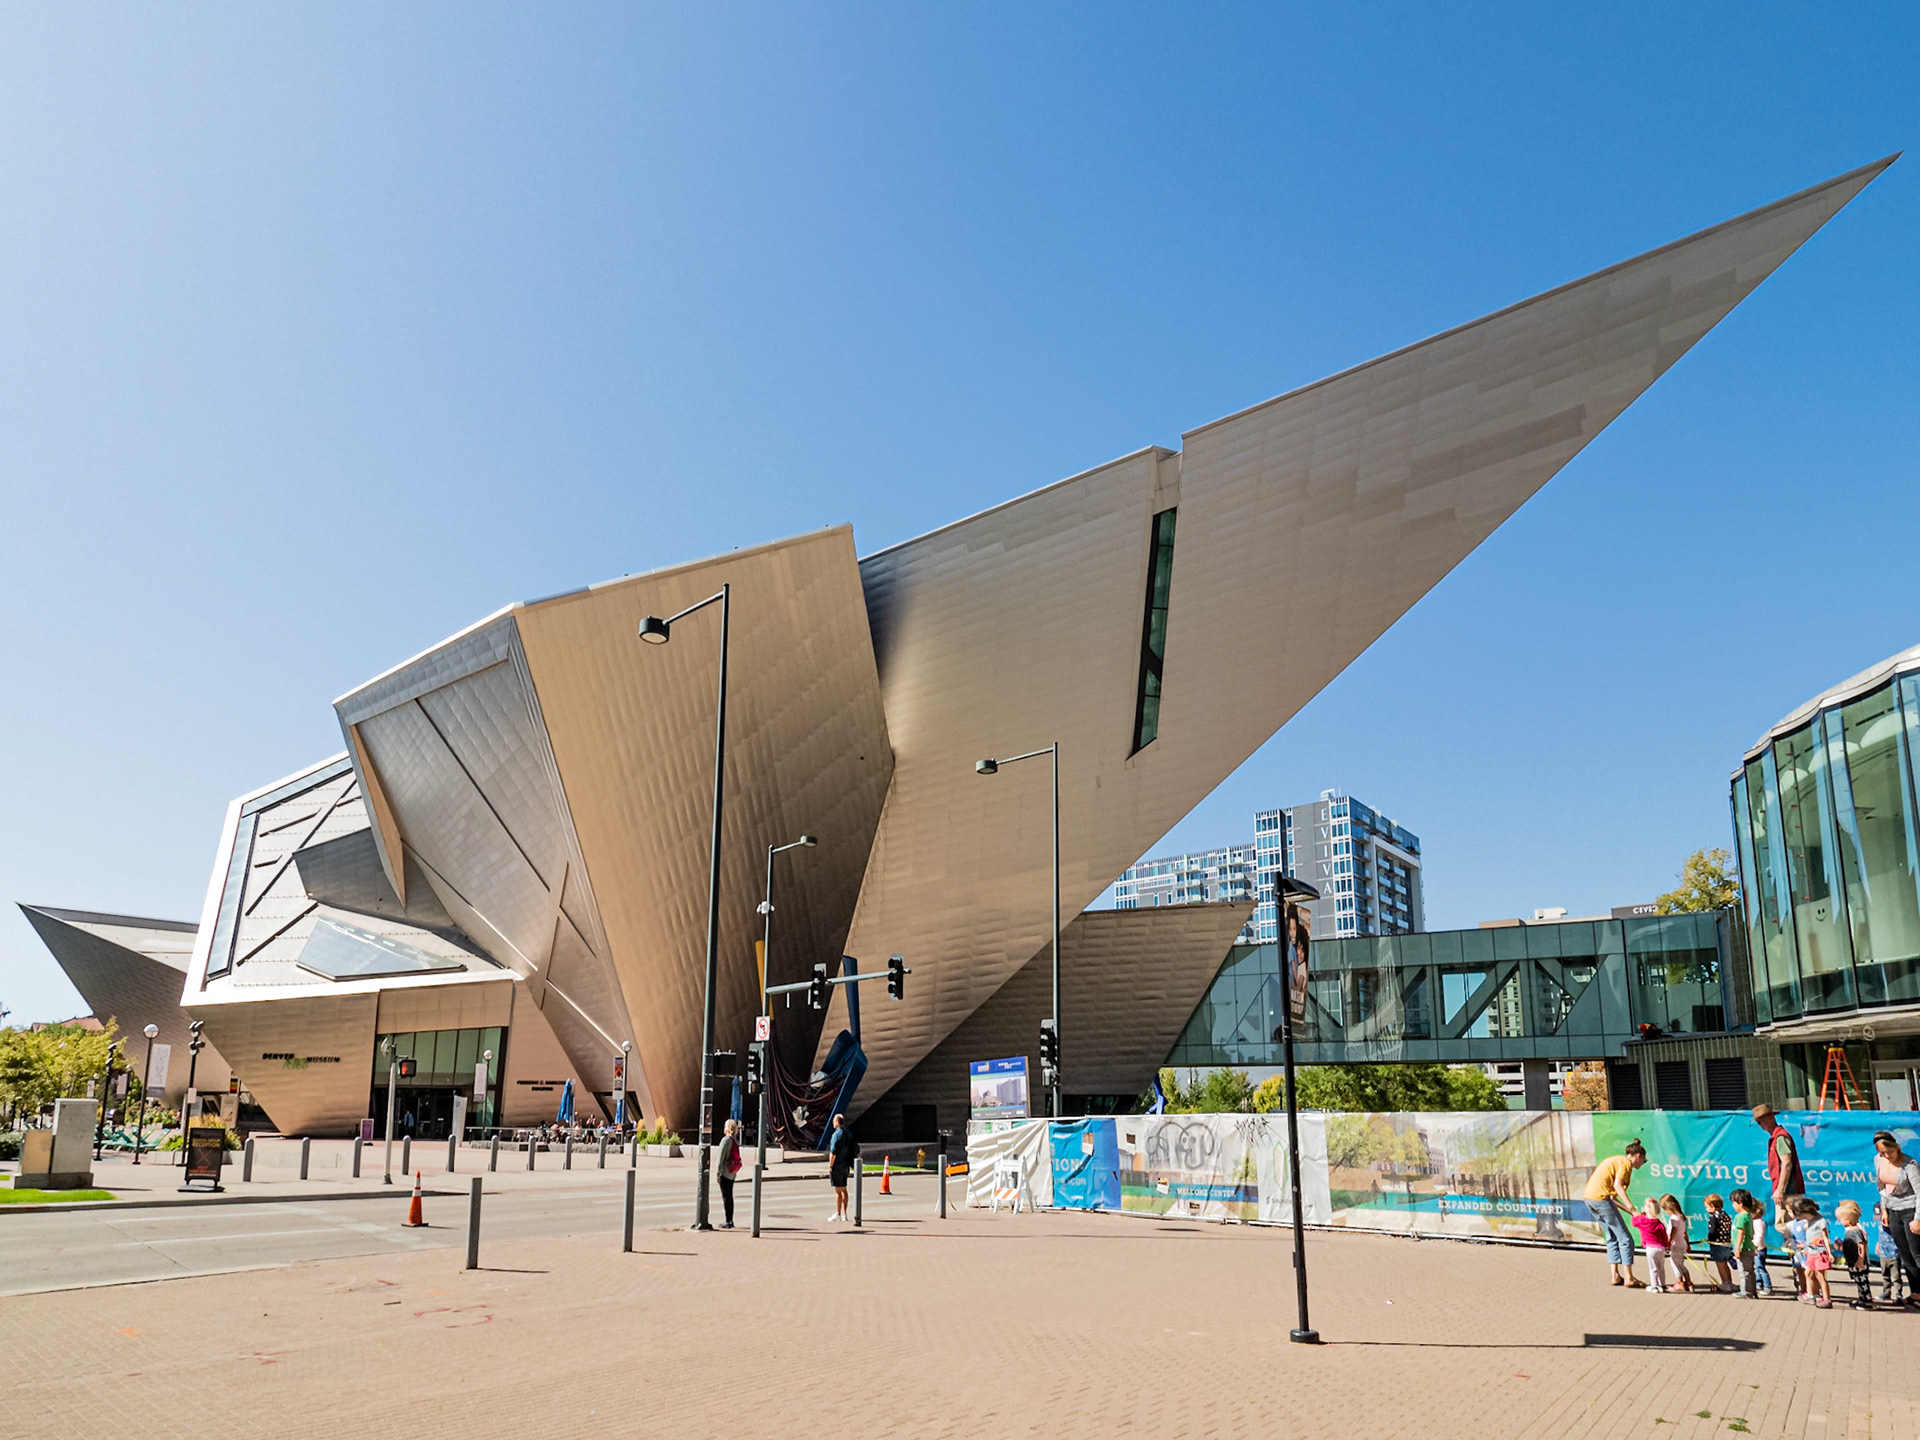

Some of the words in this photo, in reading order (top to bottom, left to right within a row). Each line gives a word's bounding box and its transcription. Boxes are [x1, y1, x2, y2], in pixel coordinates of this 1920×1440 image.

[1320, 808, 1332, 894] EVIVA
[1650, 1159, 1749, 1185] serving
[1806, 1169, 1878, 1184] COMMU
[1177, 1187, 1208, 1196] WELCOME
[1209, 1189, 1236, 1198] CENTER
[1438, 1200, 1493, 1212] EXPANDED
[1496, 1202, 1564, 1215] COURTYARD
